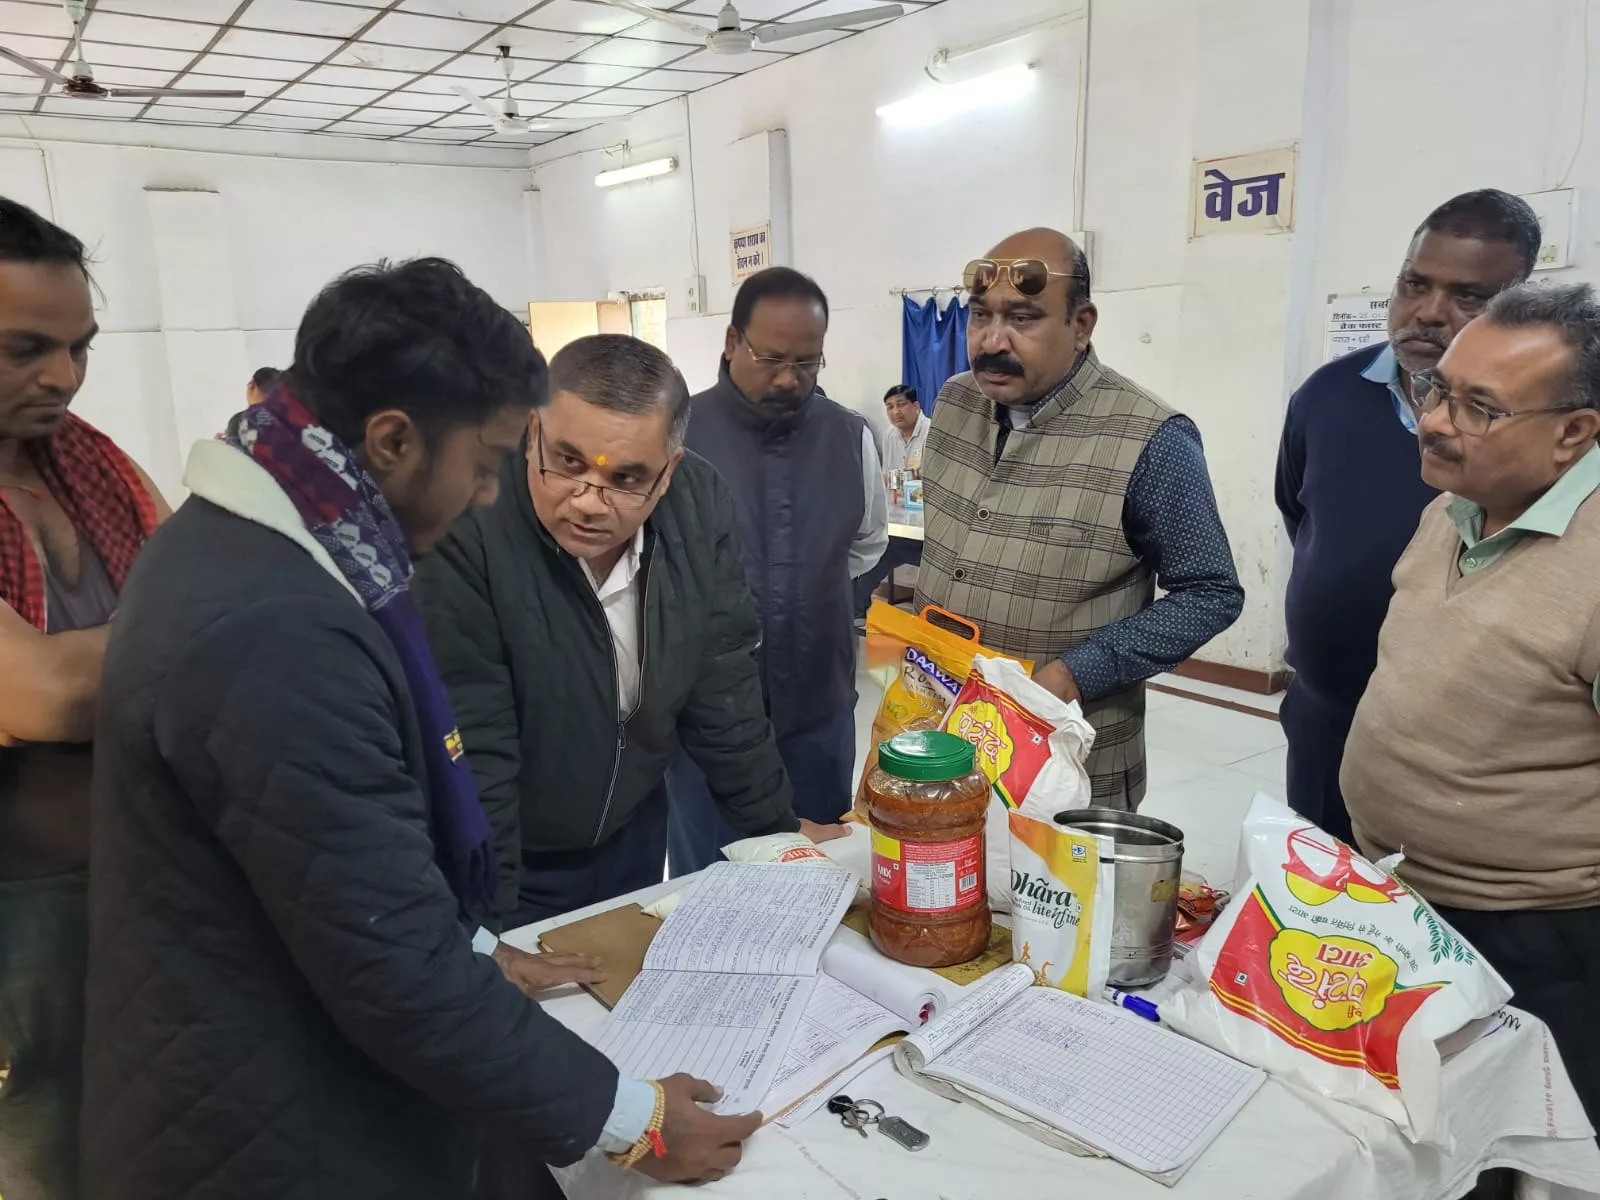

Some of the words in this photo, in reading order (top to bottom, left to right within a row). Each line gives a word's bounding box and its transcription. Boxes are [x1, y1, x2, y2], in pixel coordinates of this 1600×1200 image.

[1203, 168, 1286, 221] वेज
[905, 647, 961, 693] DAAWA
[878, 864, 892, 880] MIX
[1289, 905, 1309, 919] आटा
[1314, 943, 1374, 969] आटा
[1277, 952, 1368, 1010] पसंद
